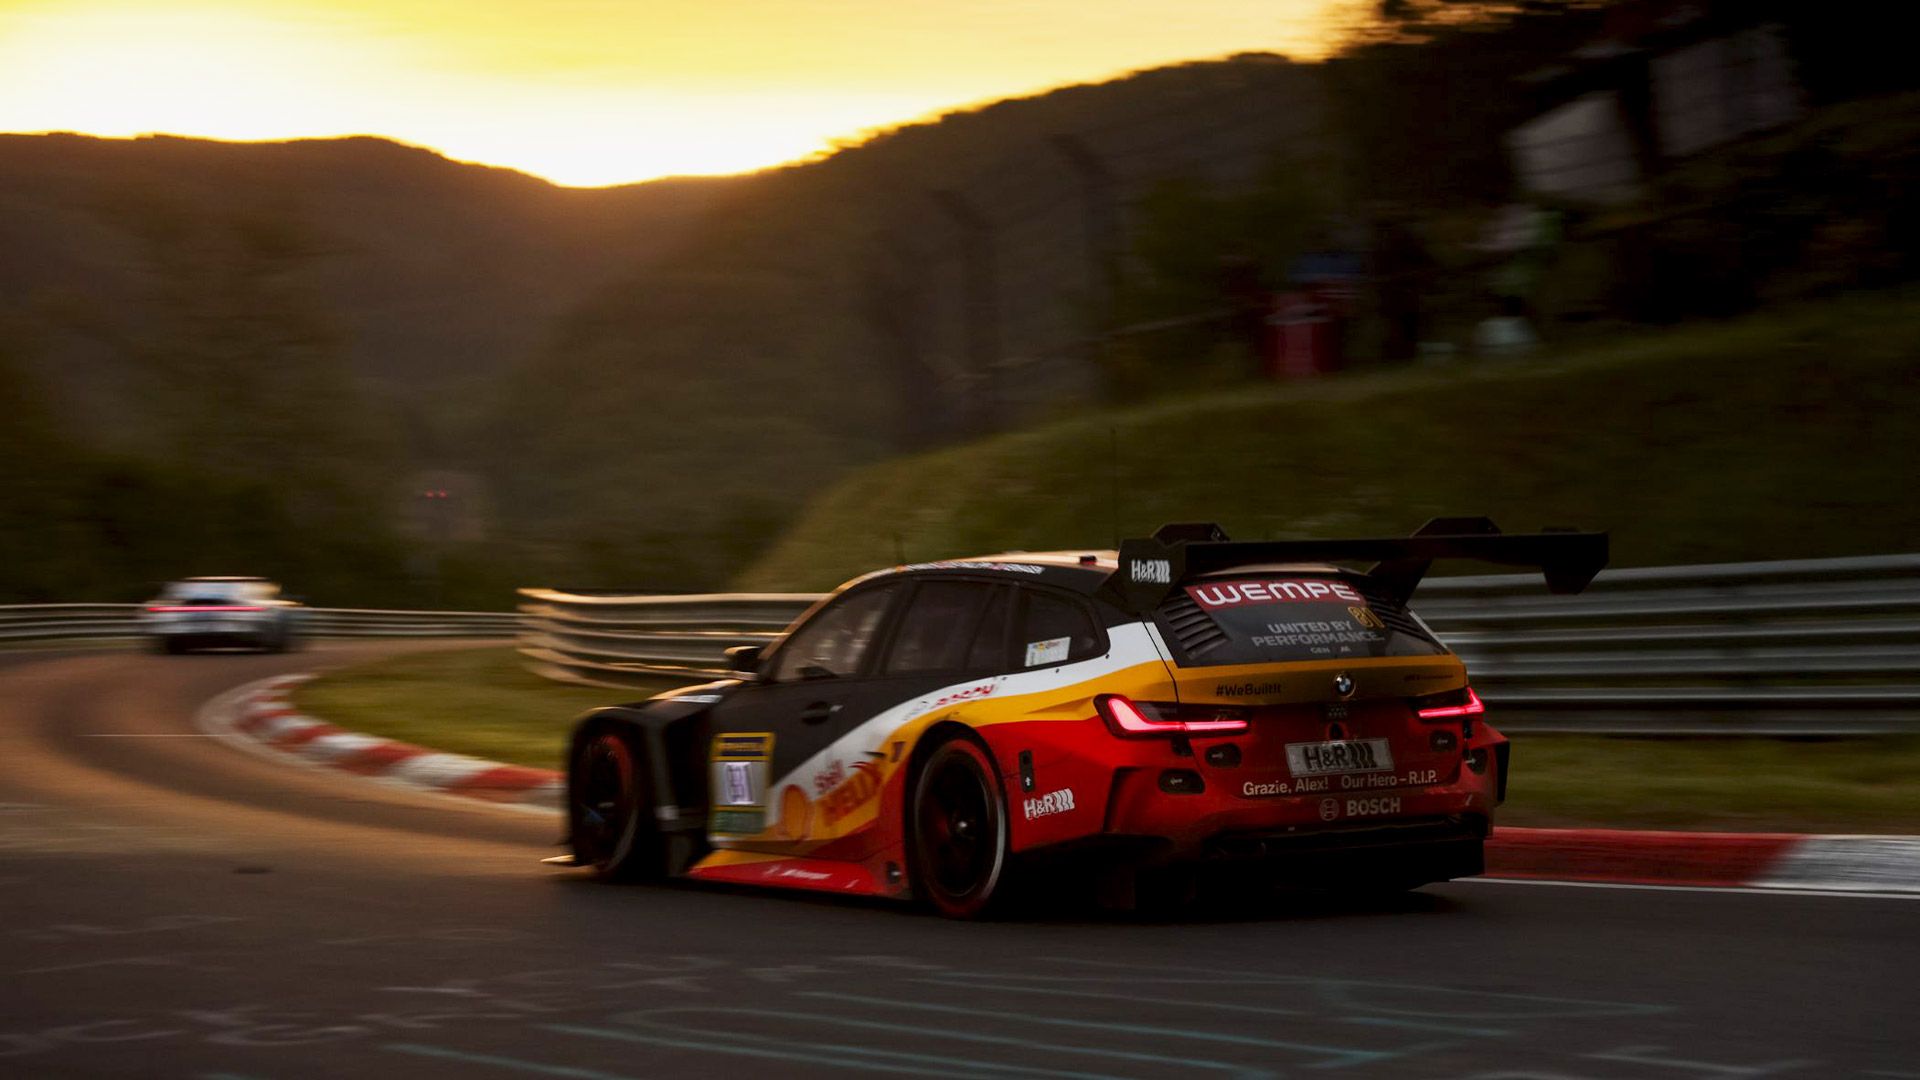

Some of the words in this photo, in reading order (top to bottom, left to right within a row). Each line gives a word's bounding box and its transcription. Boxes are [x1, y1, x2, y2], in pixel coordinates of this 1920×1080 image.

[1196, 581, 1360, 605] WEMPE
[1267, 621, 1329, 634] UNITED
[1330, 620, 1353, 632] BY
[1243, 781, 1292, 796] Grazie,
[1295, 776, 1329, 792] Alex!
[1341, 775, 1366, 789] Our
[1346, 797, 1401, 817] BOSCH
